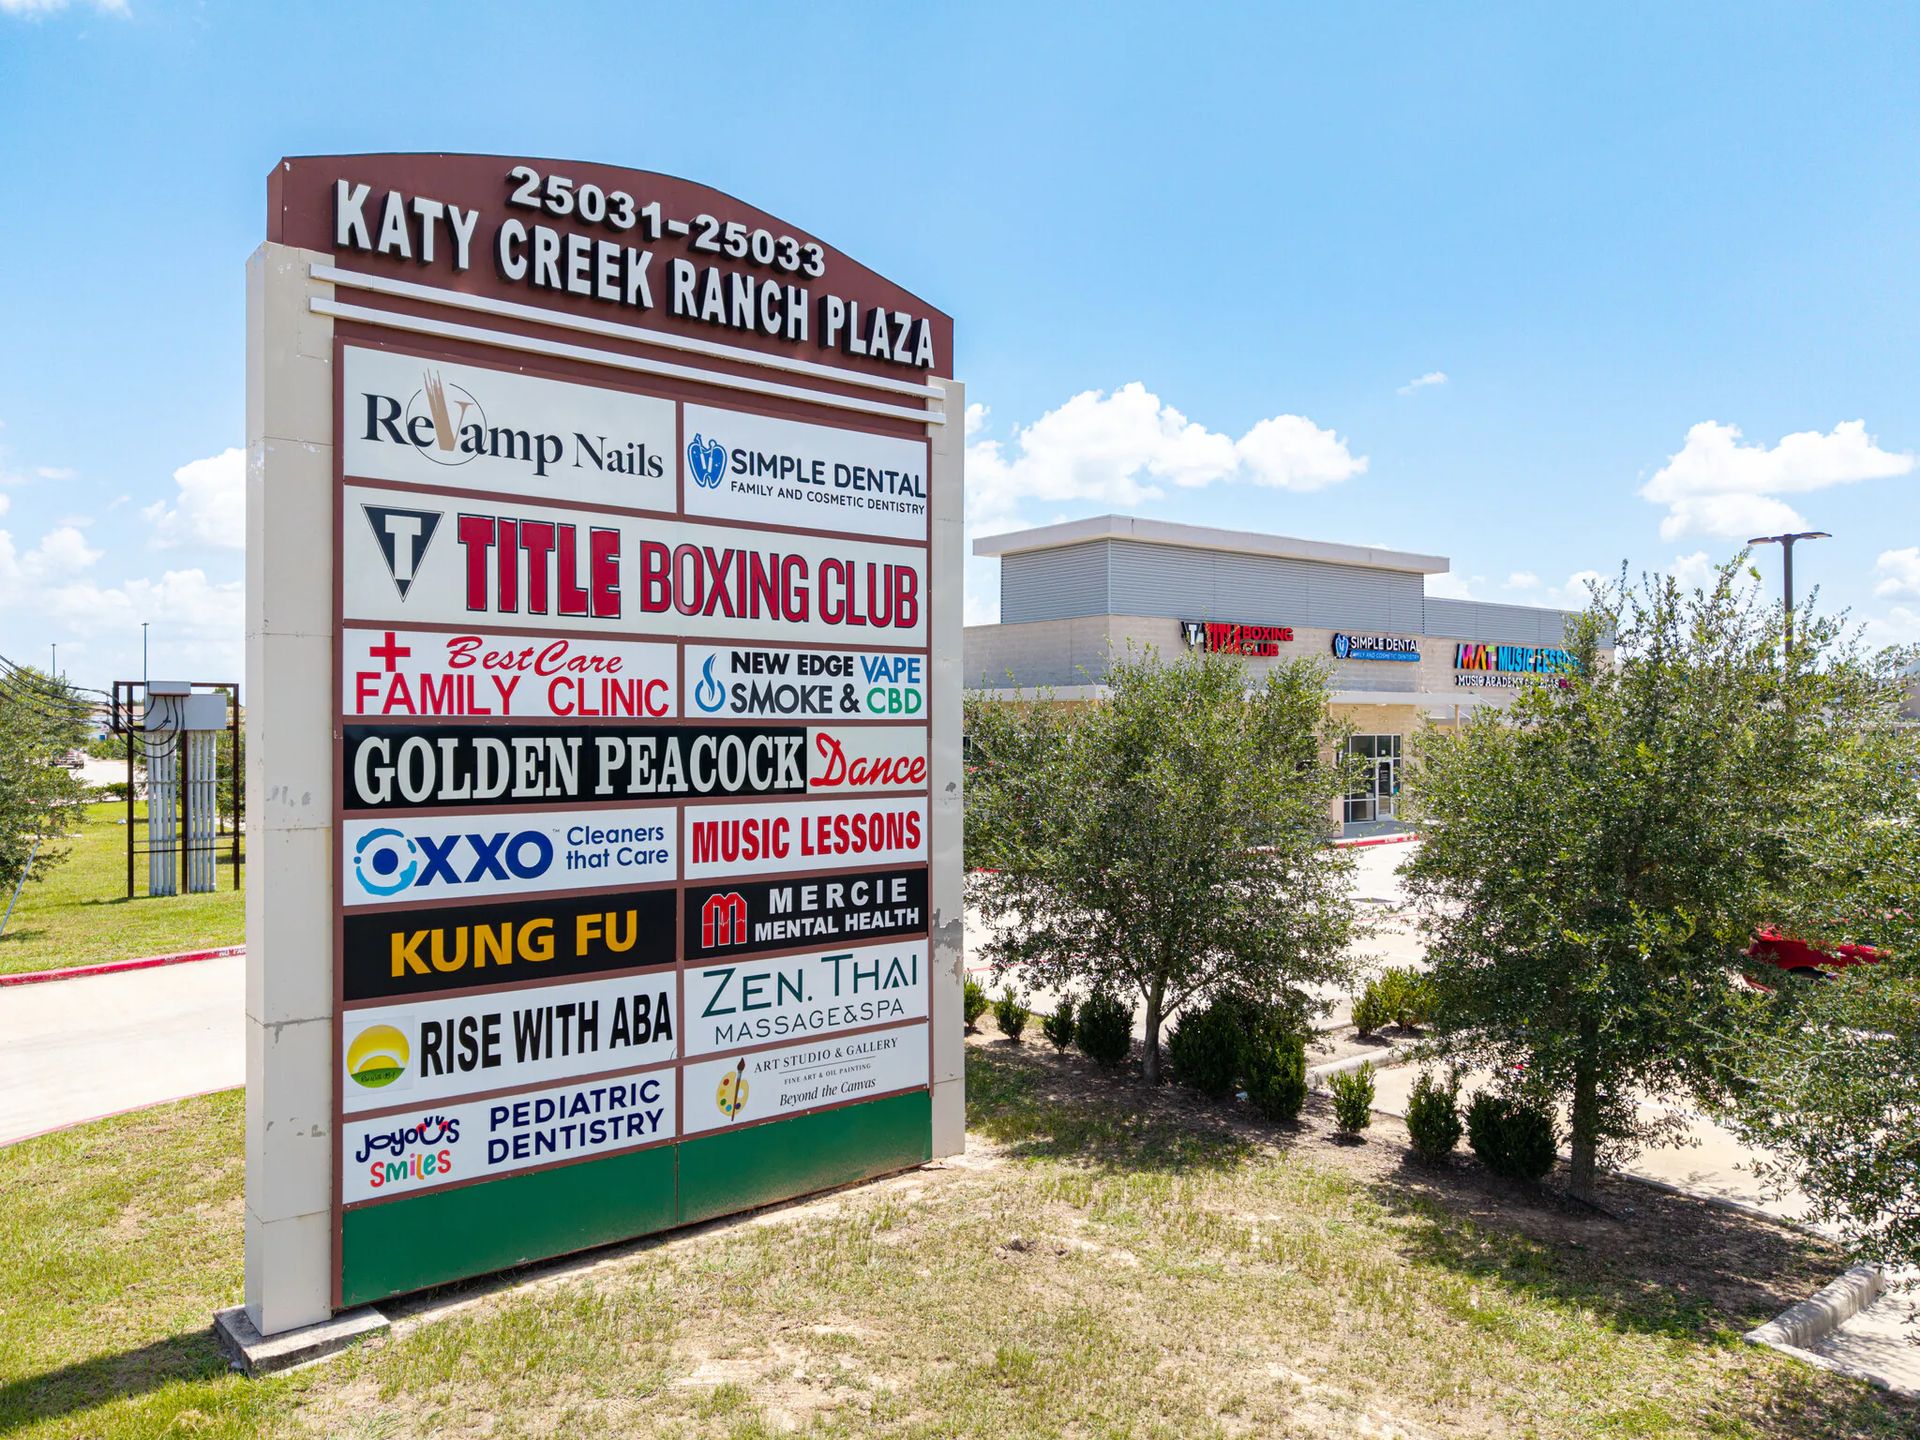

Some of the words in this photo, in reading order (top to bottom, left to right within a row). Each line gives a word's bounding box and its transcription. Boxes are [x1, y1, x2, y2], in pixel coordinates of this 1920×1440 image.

[509, 165, 826, 278] 25031-25033
[335, 178, 480, 271] KATY
[499, 217, 655, 310] CREEK
[673, 257, 809, 343] RANCH
[827, 295, 935, 369] PLAZA
[360, 367, 564, 477] ReVamp
[572, 432, 664, 478] Nails
[731, 448, 826, 485] SIMPLE
[834, 463, 927, 498] DENTAL
[731, 480, 774, 497] FAMILY
[777, 489, 803, 500] AND
[806, 491, 864, 508] COSMETIC
[867, 498, 925, 515] DENTISTRY
[457, 512, 621, 619] TITLE
[639, 540, 809, 622] BOXING
[818, 556, 919, 629] CLUB
[1242, 625, 1294, 641] BOXING
[1350, 636, 1384, 650] SIMPLE
[1386, 638, 1420, 652] DENTAL
[731, 651, 790, 675] NEW
[797, 654, 853, 677] EDGE
[860, 655, 921, 685] VAPE
[1498, 646, 1535, 672] MUSIC
[356, 672, 521, 715] FAMILY
[547, 676, 670, 717] CLINIC
[730, 680, 833, 715] SMOKE
[839, 683, 861, 713] &
[866, 687, 922, 714] CBD
[1458, 675, 1484, 687] MUSIC
[354, 735, 583, 803] GOLDEN
[594, 734, 804, 796] PEACOCK
[809, 732, 927, 787] Dance
[567, 826, 664, 846] Cleaners
[692, 817, 790, 864] MUSIC
[801, 810, 921, 857] LESSONS
[566, 848, 610, 870] that
[617, 847, 669, 866] Care
[769, 877, 907, 914] MERCIE
[391, 918, 555, 978] KUNG
[576, 910, 638, 957] FU
[754, 917, 839, 942] MENTAL
[845, 907, 920, 932] HEALTH
[821, 953, 917, 996] THAI
[420, 1012, 501, 1078] RISE
[513, 1000, 599, 1063] WITH
[609, 991, 673, 1049] ABA
[754, 1059, 780, 1074] ART
[783, 1051, 831, 1067] STUDIO
[835, 1047, 843, 1058] &
[846, 1037, 898, 1056] GALLERY
[784, 1076, 801, 1085] FINE
[803, 1073, 817, 1081] ART
[826, 1069, 837, 1077] OIL
[839, 1063, 871, 1075] PAINTING
[490, 1079, 660, 1132] PEDIATRIC
[780, 1086, 818, 1107] Beyond
[821, 1083, 838, 1098] the
[840, 1078, 876, 1094] Canvas
[488, 1107, 664, 1165] DENTISTRY
